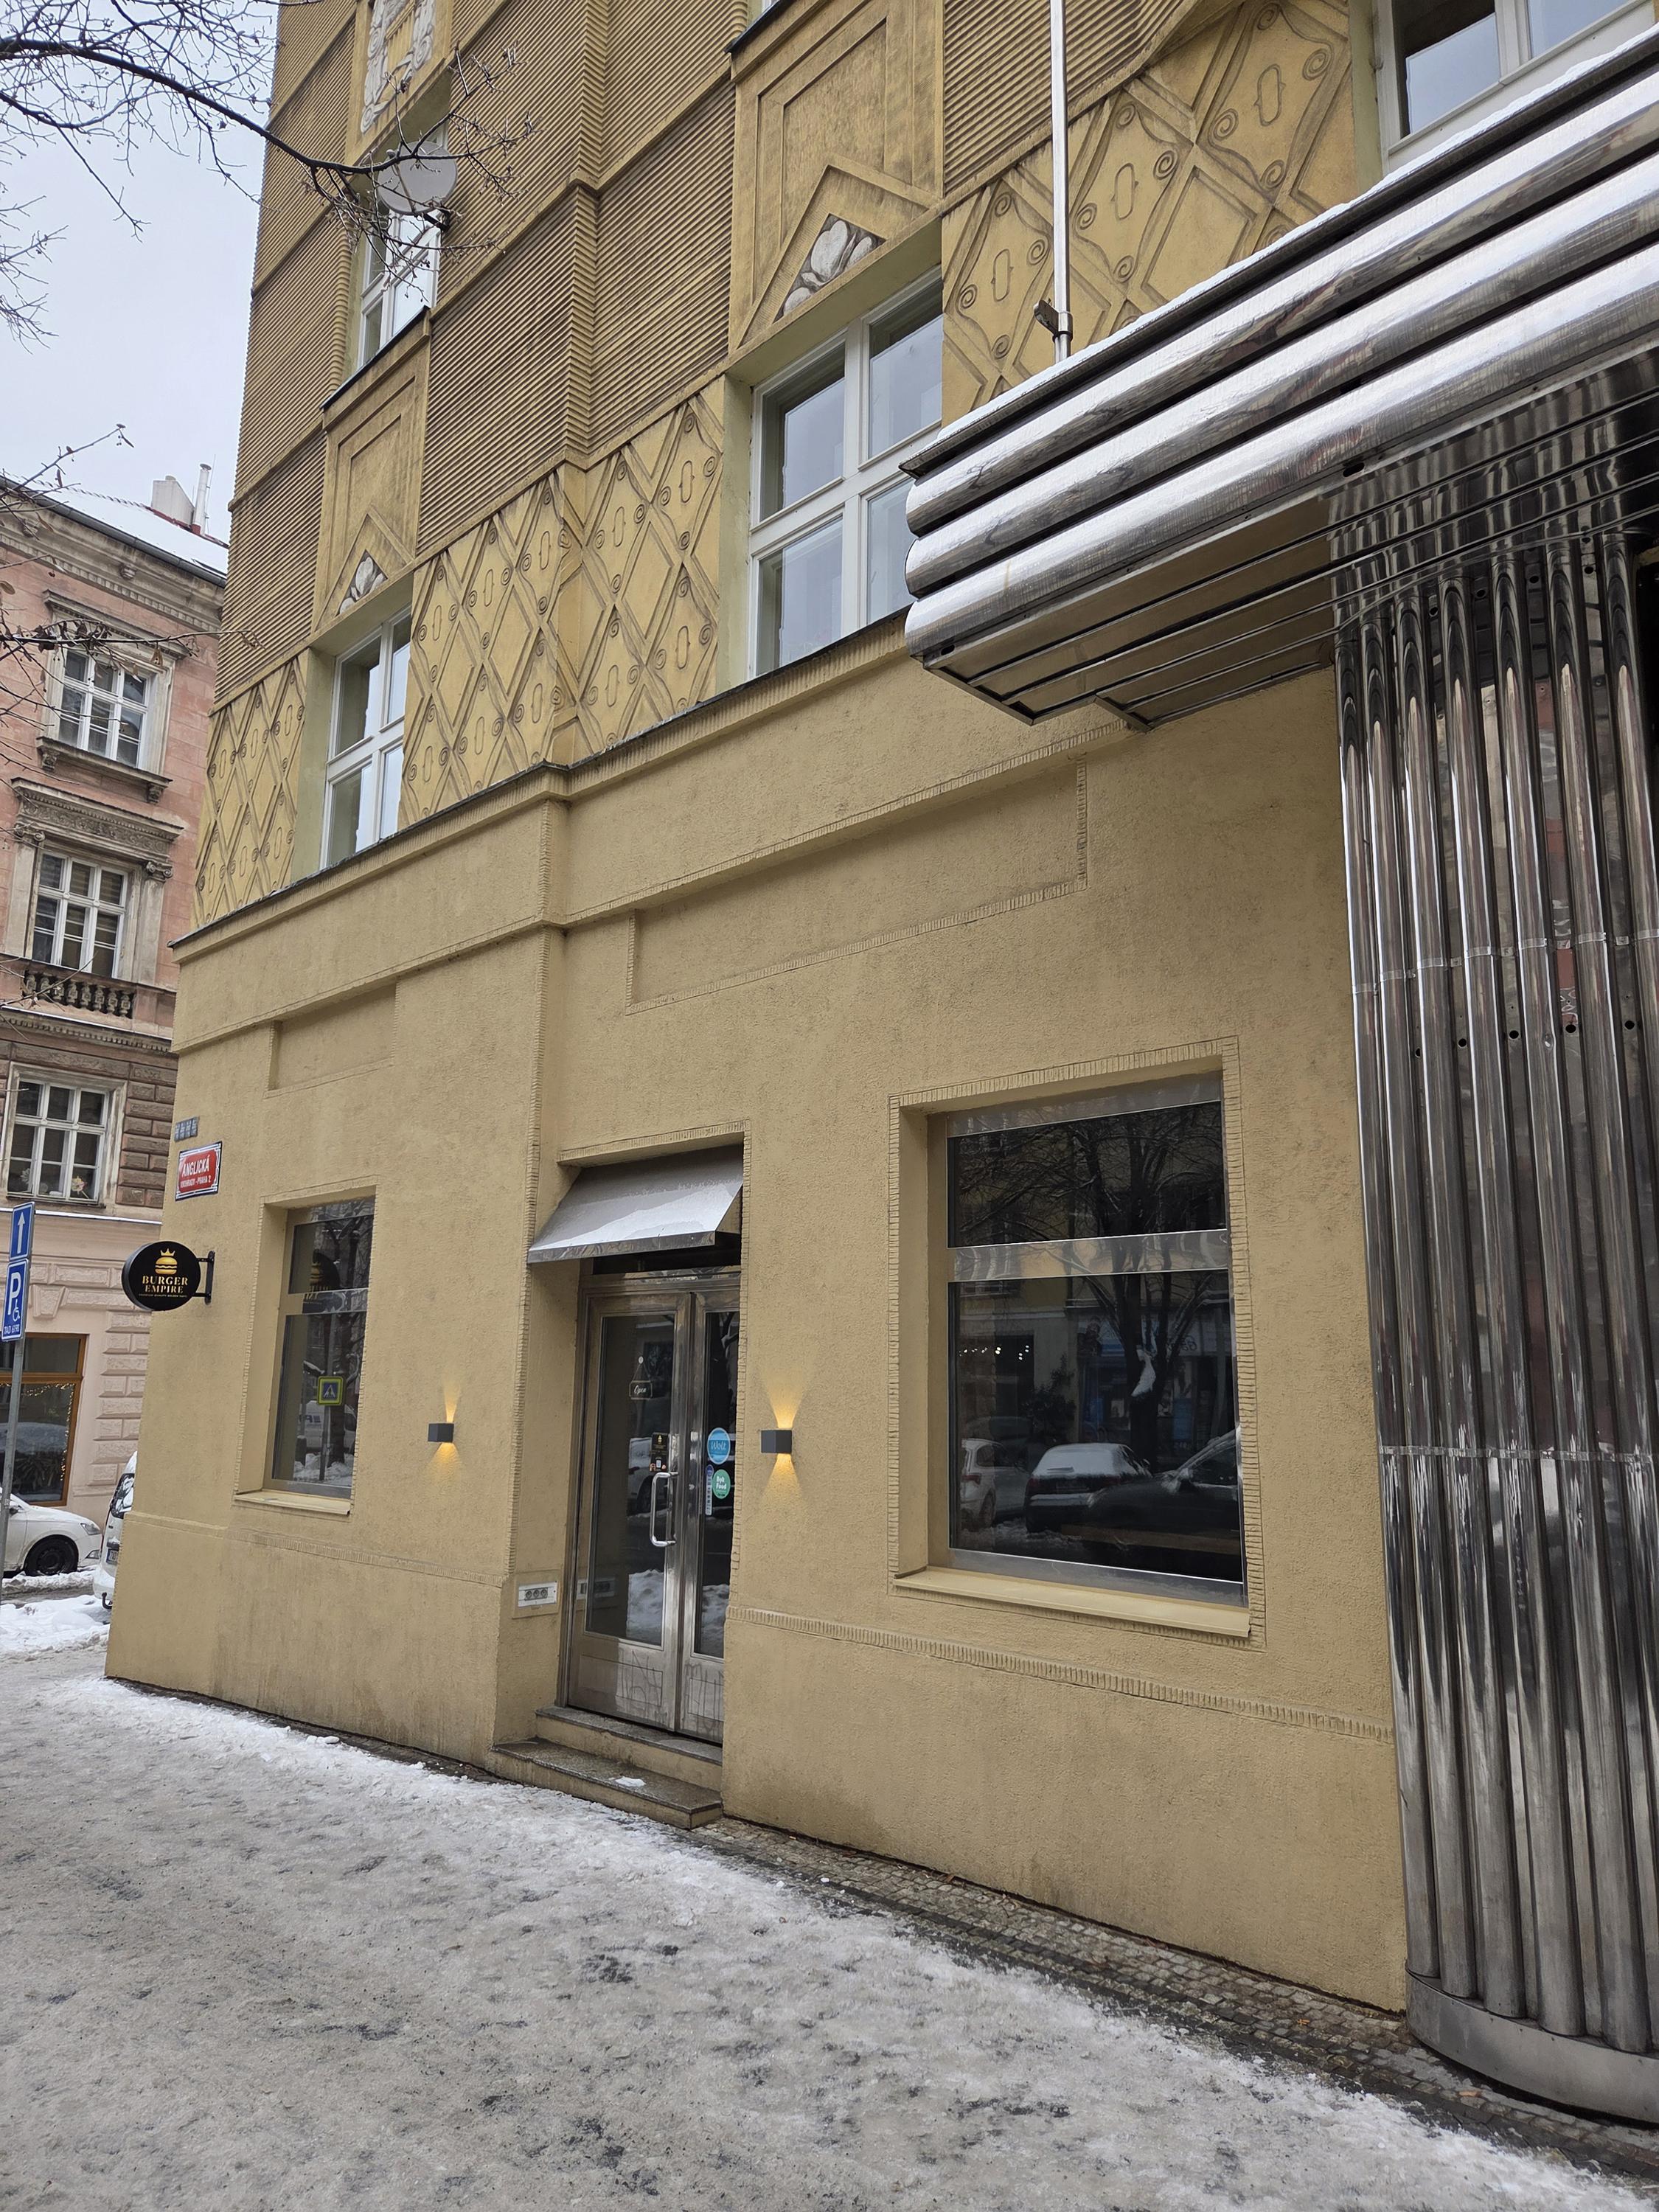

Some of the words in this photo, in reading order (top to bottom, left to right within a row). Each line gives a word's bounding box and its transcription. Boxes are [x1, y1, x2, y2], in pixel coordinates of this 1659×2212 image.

[182, 1155, 210, 1178] ANGLICKÁ
[142, 1276, 188, 1285] BURGER
[7, 1272, 21, 1315] P
[145, 1284, 184, 1293] EMPIRE
[634, 1385, 647, 1395] Open
[711, 1440, 726, 1450] Wolt
